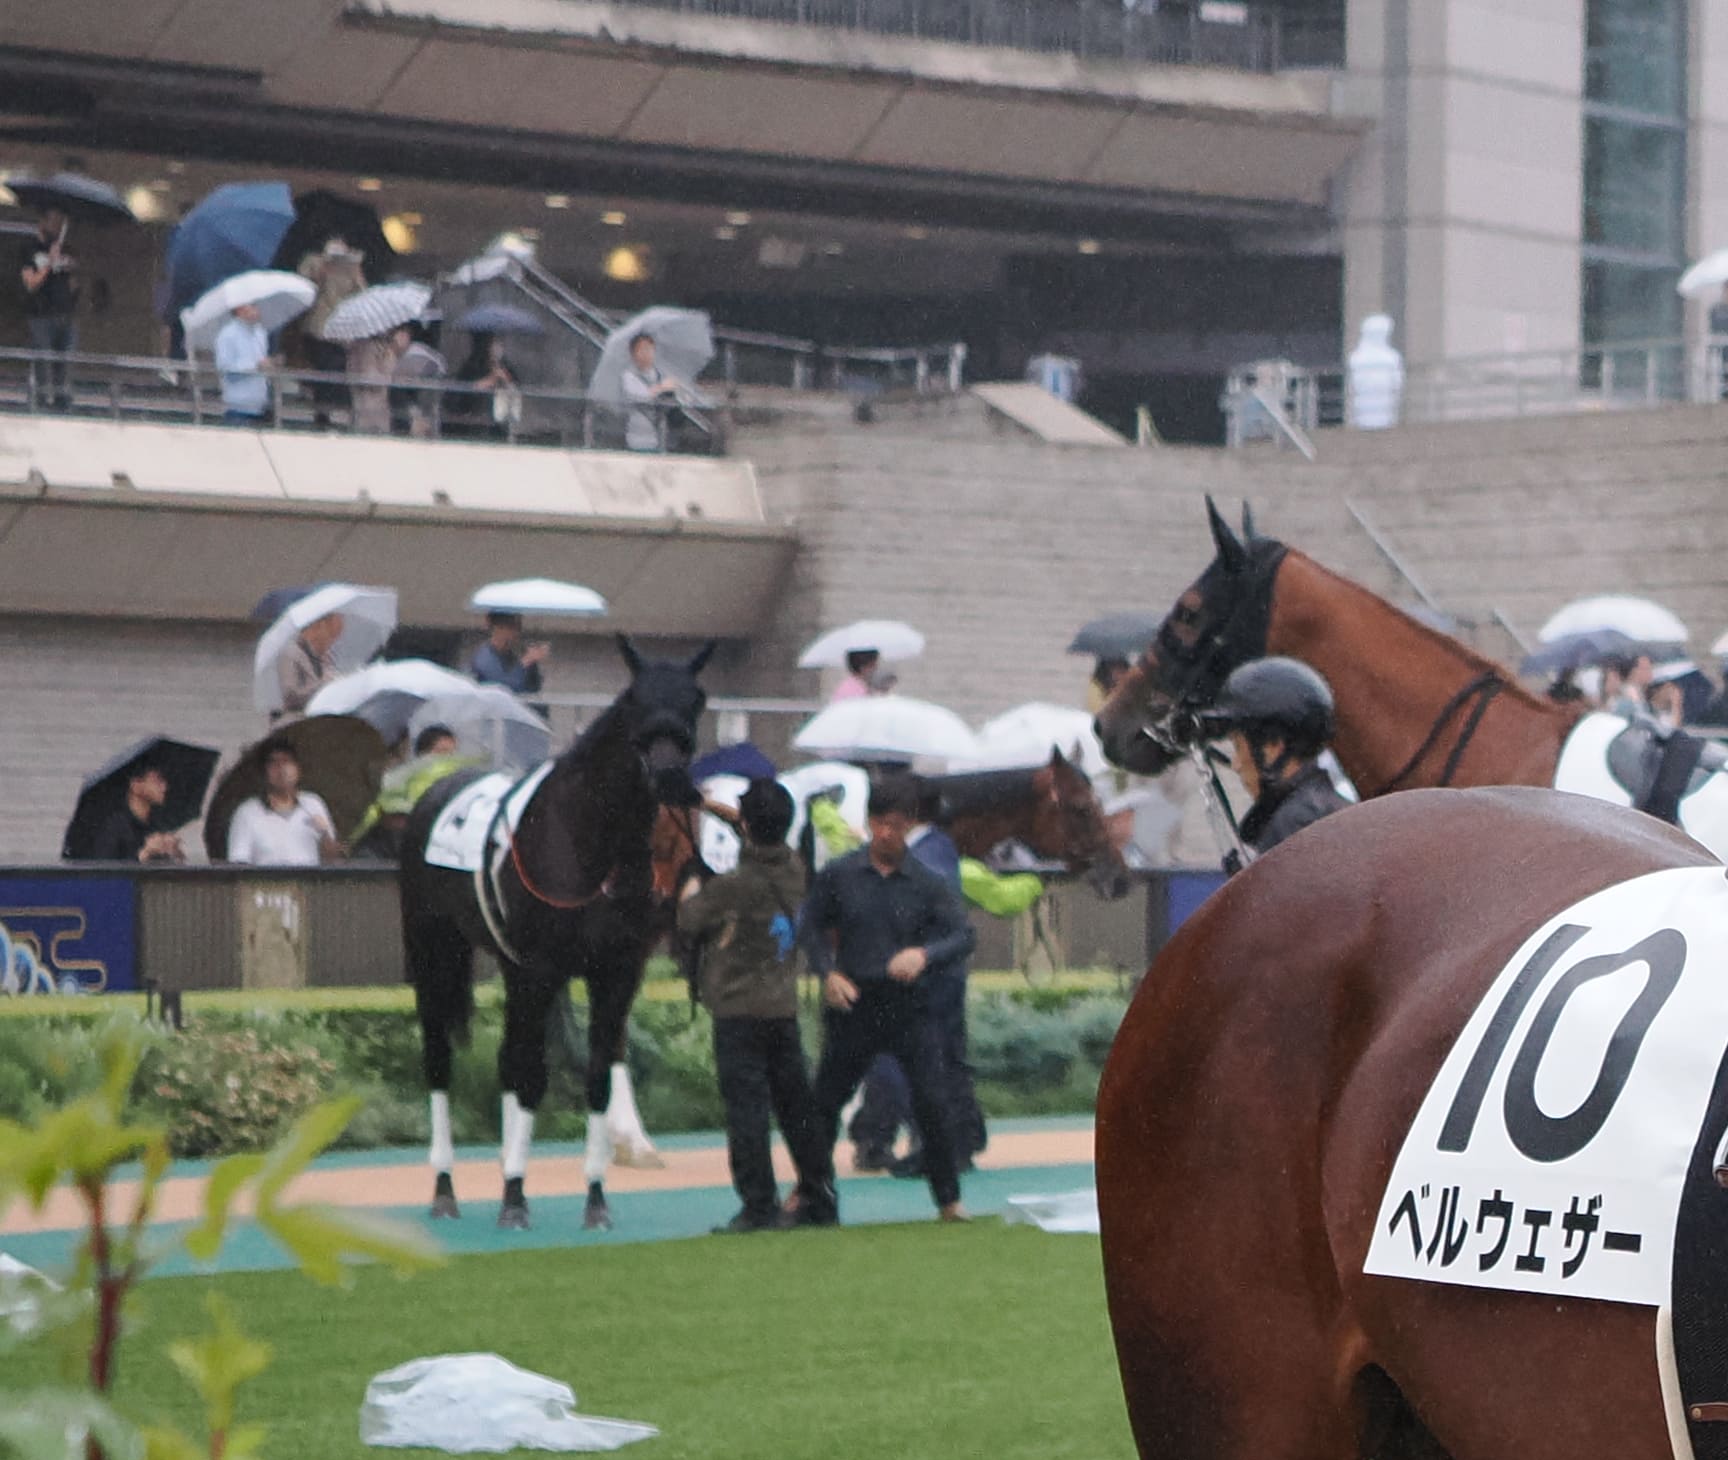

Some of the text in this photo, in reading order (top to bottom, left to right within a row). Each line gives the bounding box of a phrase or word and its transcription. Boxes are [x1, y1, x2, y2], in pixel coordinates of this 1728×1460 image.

[1436, 923, 1688, 1163] 10
[1388, 1184, 1642, 1280] ベルウェザー
